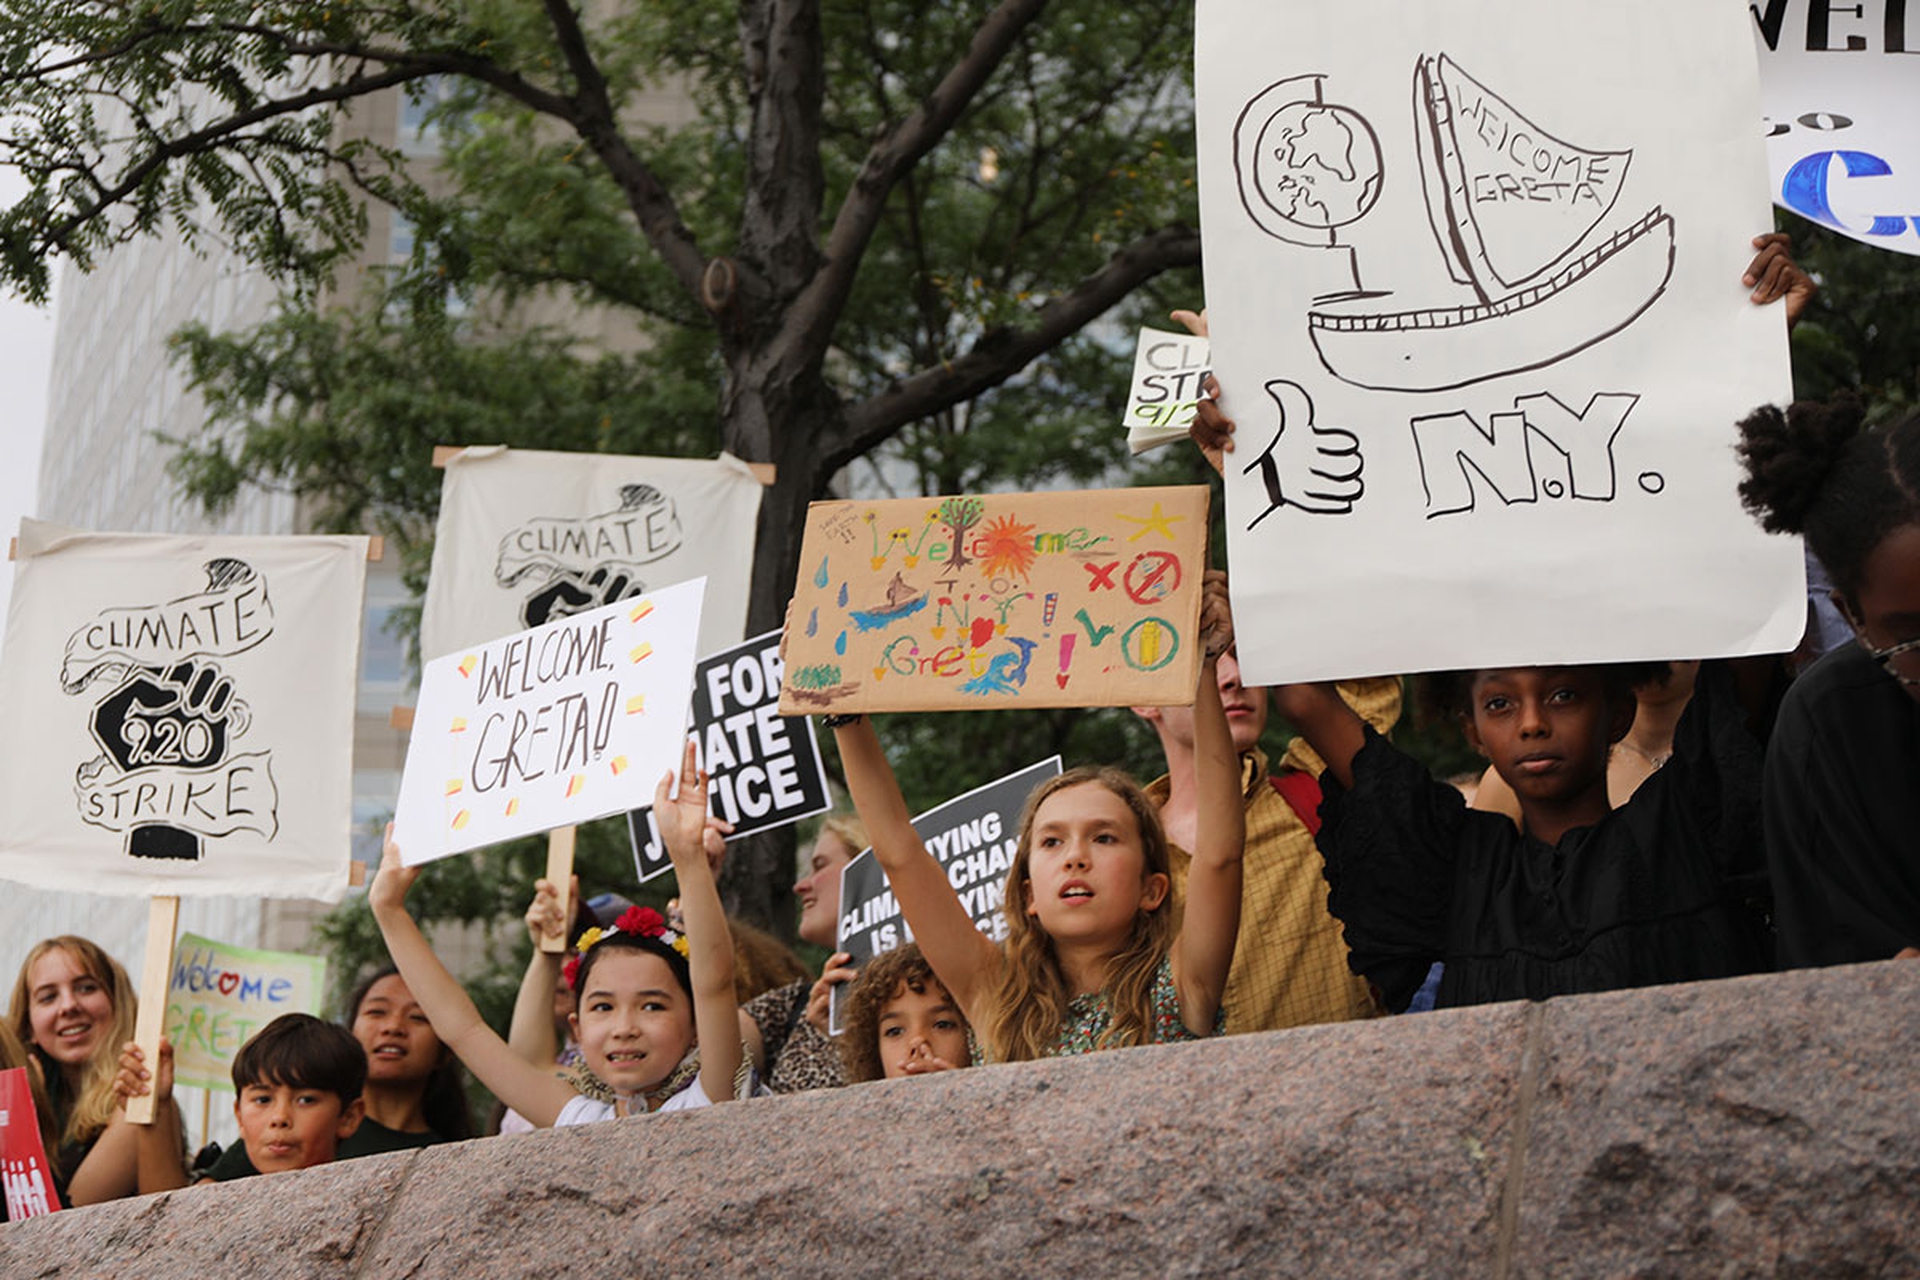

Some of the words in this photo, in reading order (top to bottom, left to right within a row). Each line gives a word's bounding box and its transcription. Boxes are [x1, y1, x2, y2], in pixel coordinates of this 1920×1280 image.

[1475, 173, 1603, 207] GRETA
[516, 507, 670, 558] CLIMATE
[86, 586, 259, 651] CLIMATE
[706, 644, 784, 718] FOR
[471, 681, 619, 793] GRETA!
[88, 766, 254, 821] STRIKE
[870, 923, 898, 957] IS
